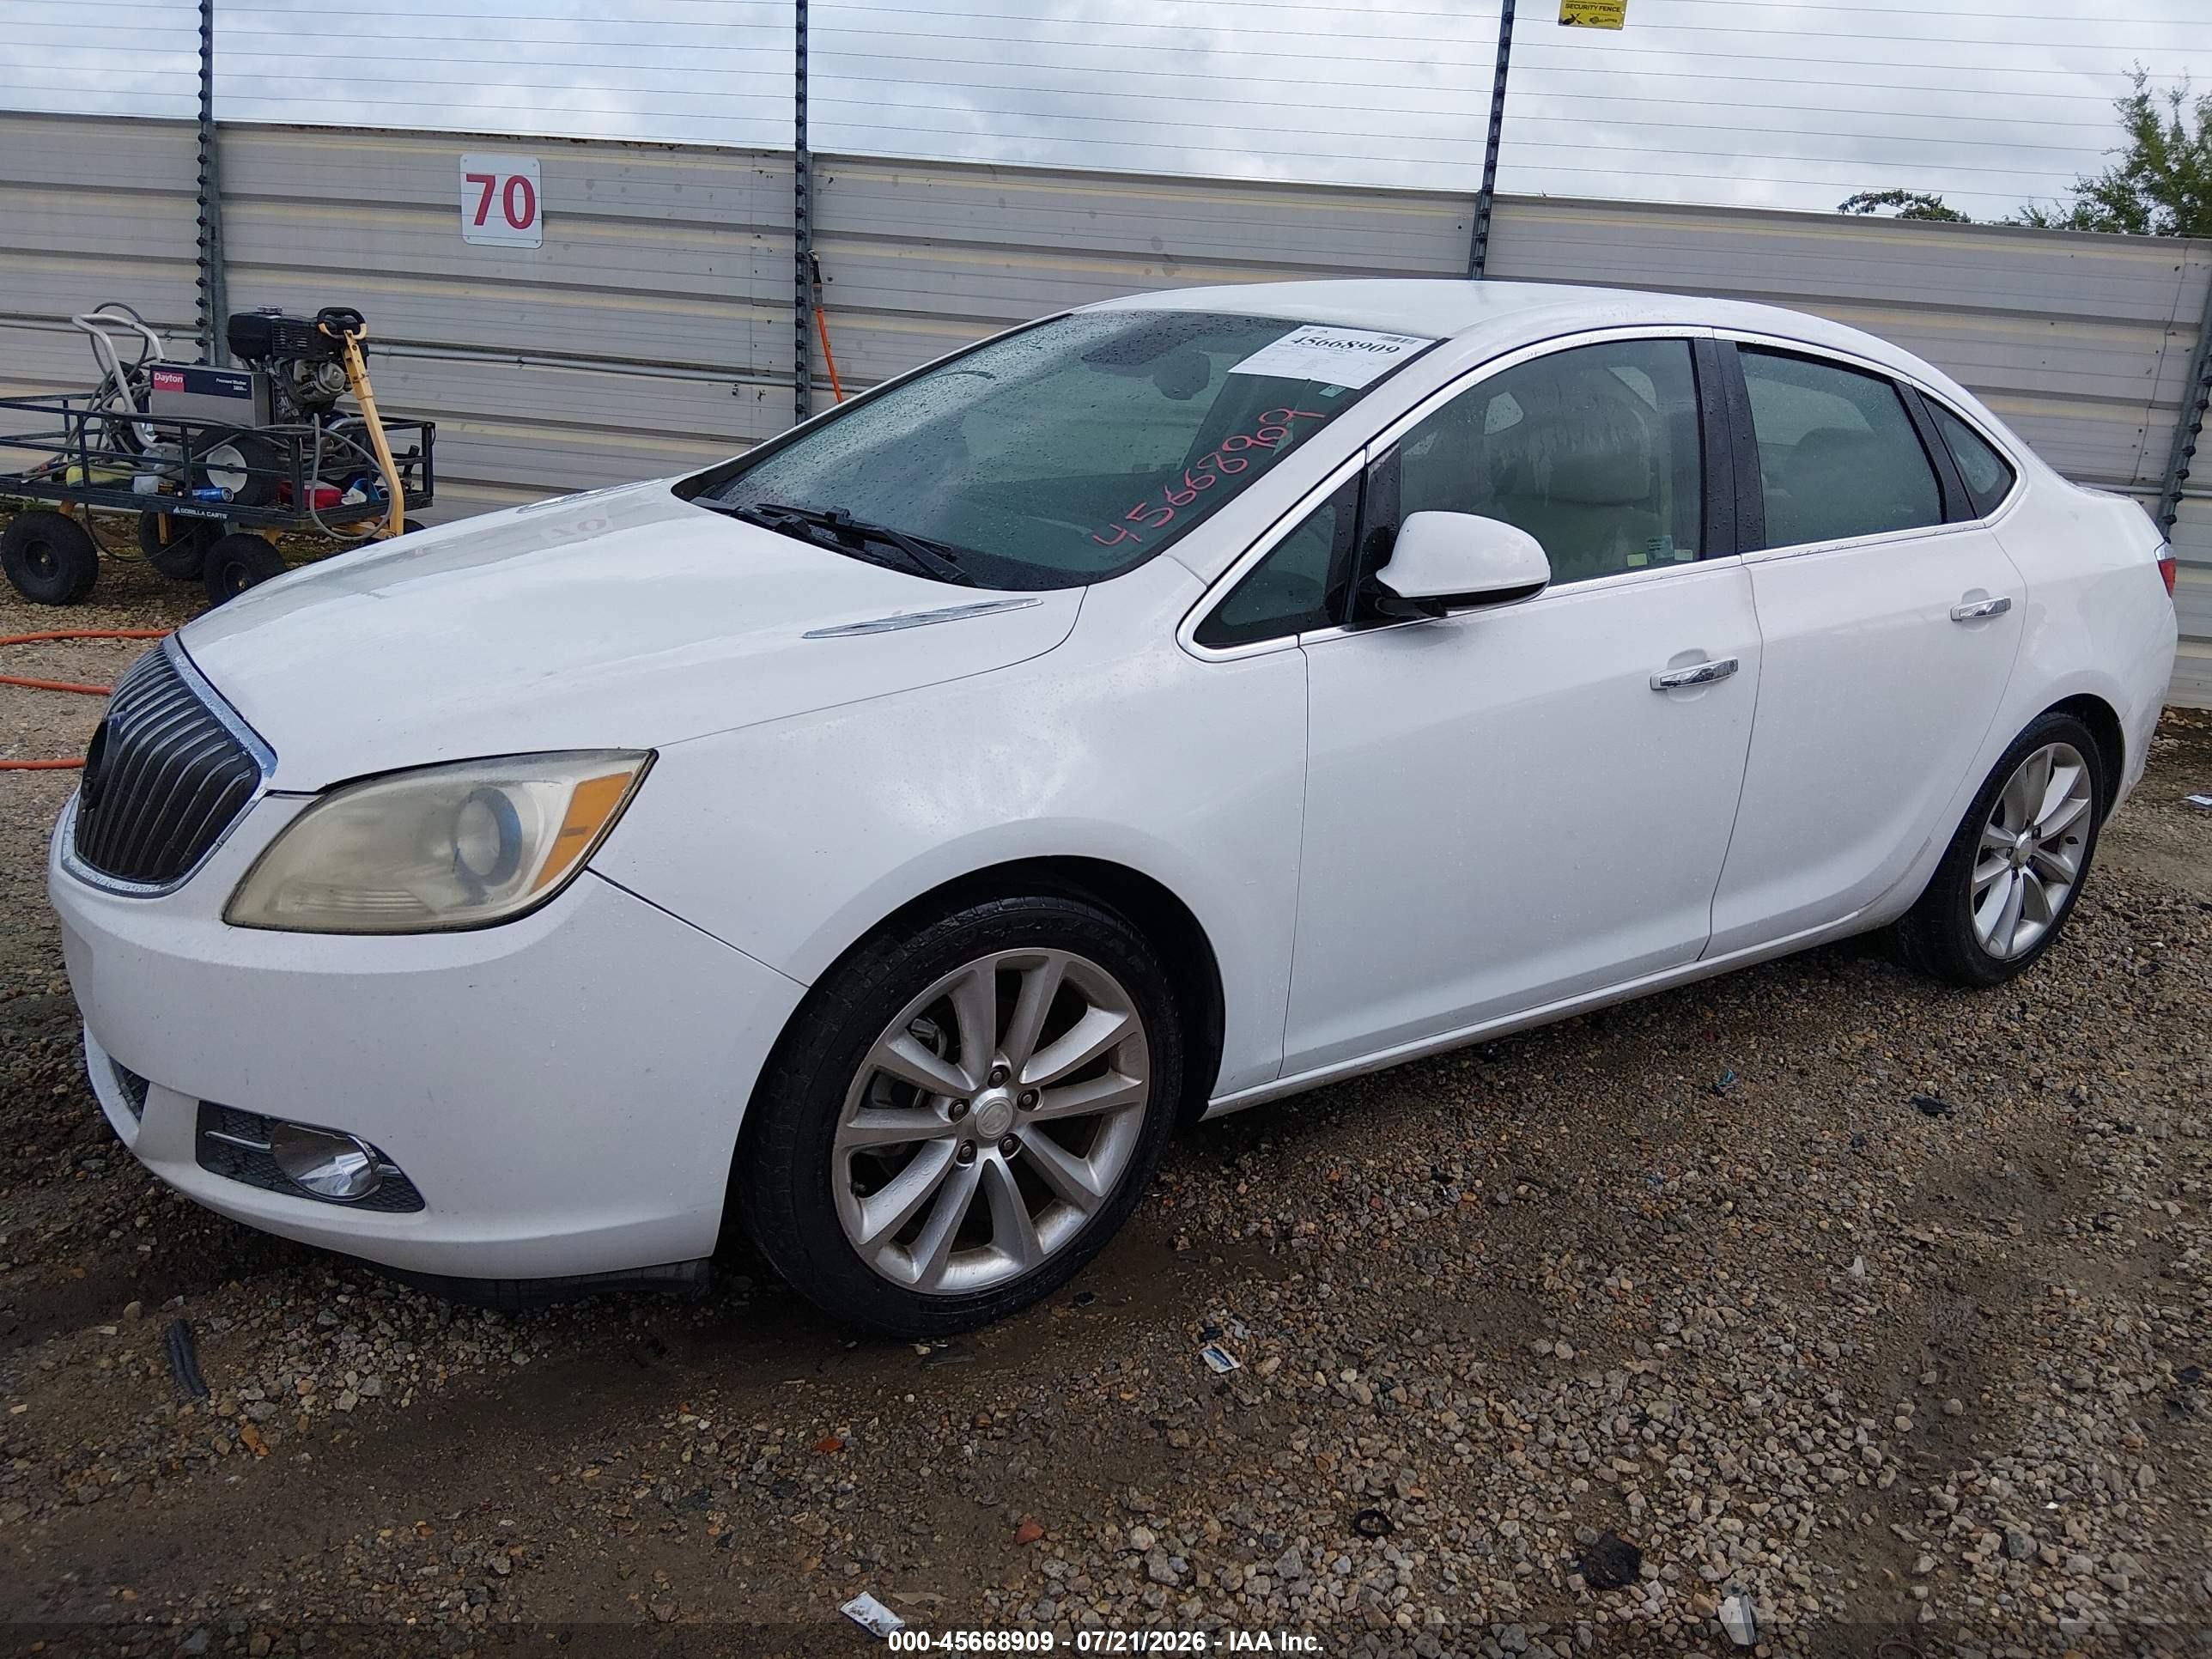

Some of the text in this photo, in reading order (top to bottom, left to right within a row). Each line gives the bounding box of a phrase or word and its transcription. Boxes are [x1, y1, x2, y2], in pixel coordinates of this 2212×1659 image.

[466, 174, 536, 229] 70
[1291, 336, 1401, 354] 45668909
[155, 373, 184, 383] Dayton
[1092, 408, 1326, 546] 45668909
